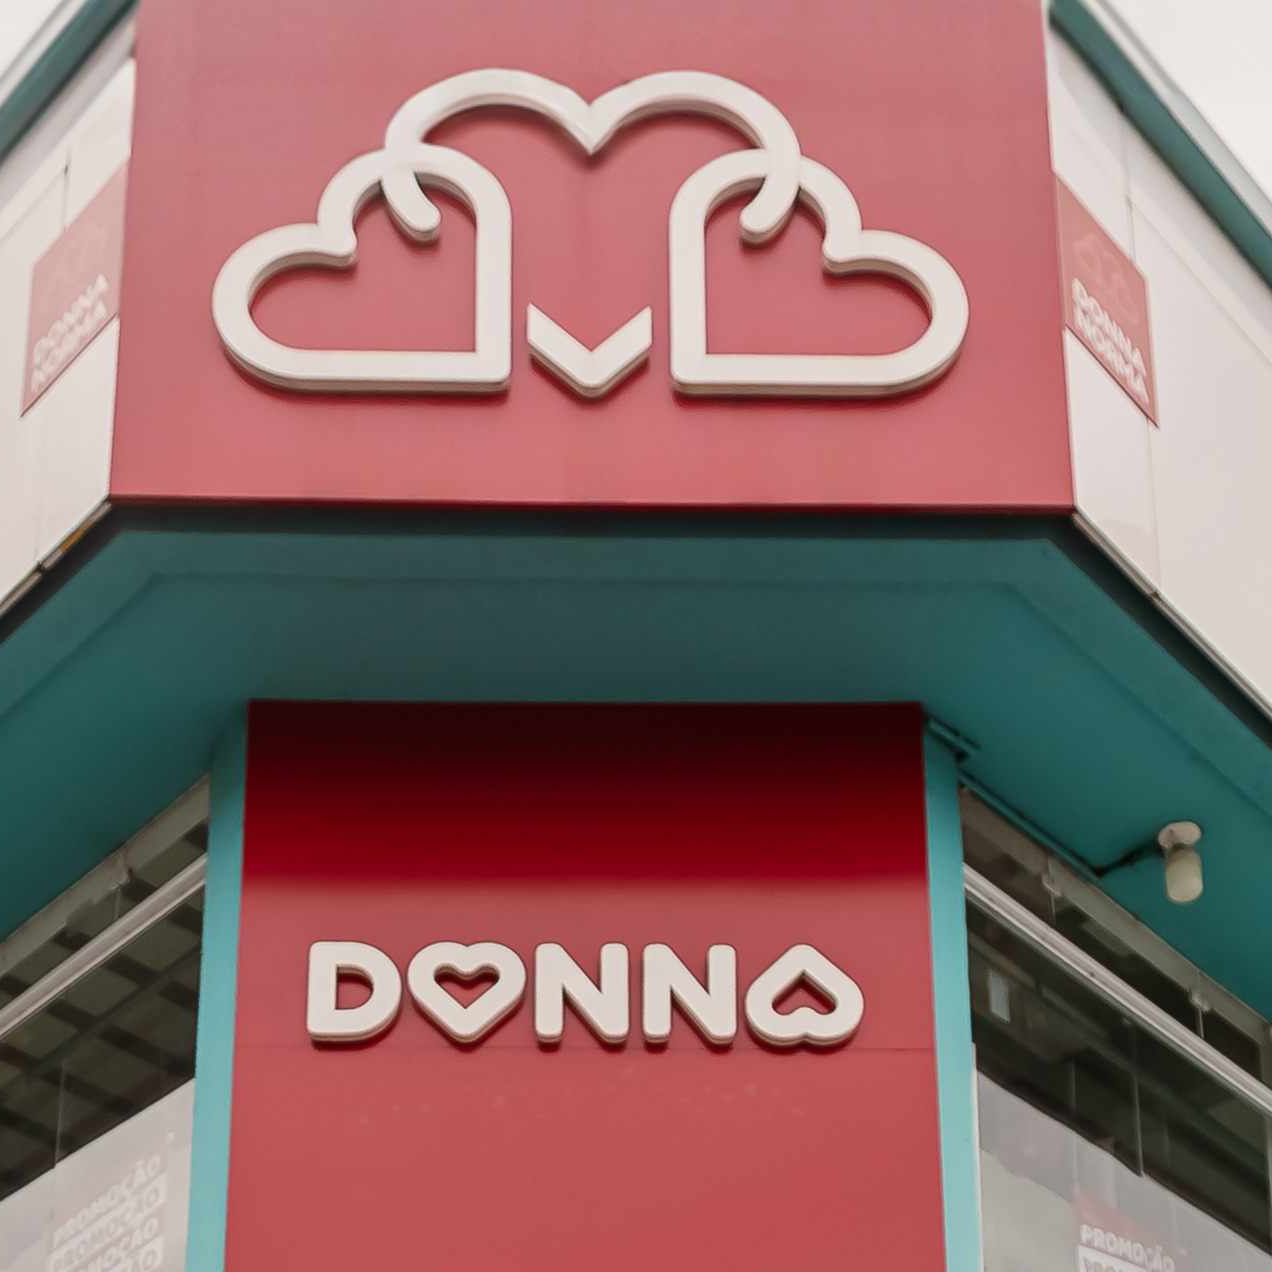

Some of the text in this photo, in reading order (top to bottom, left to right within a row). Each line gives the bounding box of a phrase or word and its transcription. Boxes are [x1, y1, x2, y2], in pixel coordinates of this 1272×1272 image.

[1072, 277, 1147, 378] DONNA
[1074, 306, 1149, 403] NORMA
[306, 940, 865, 1047] DONNA
